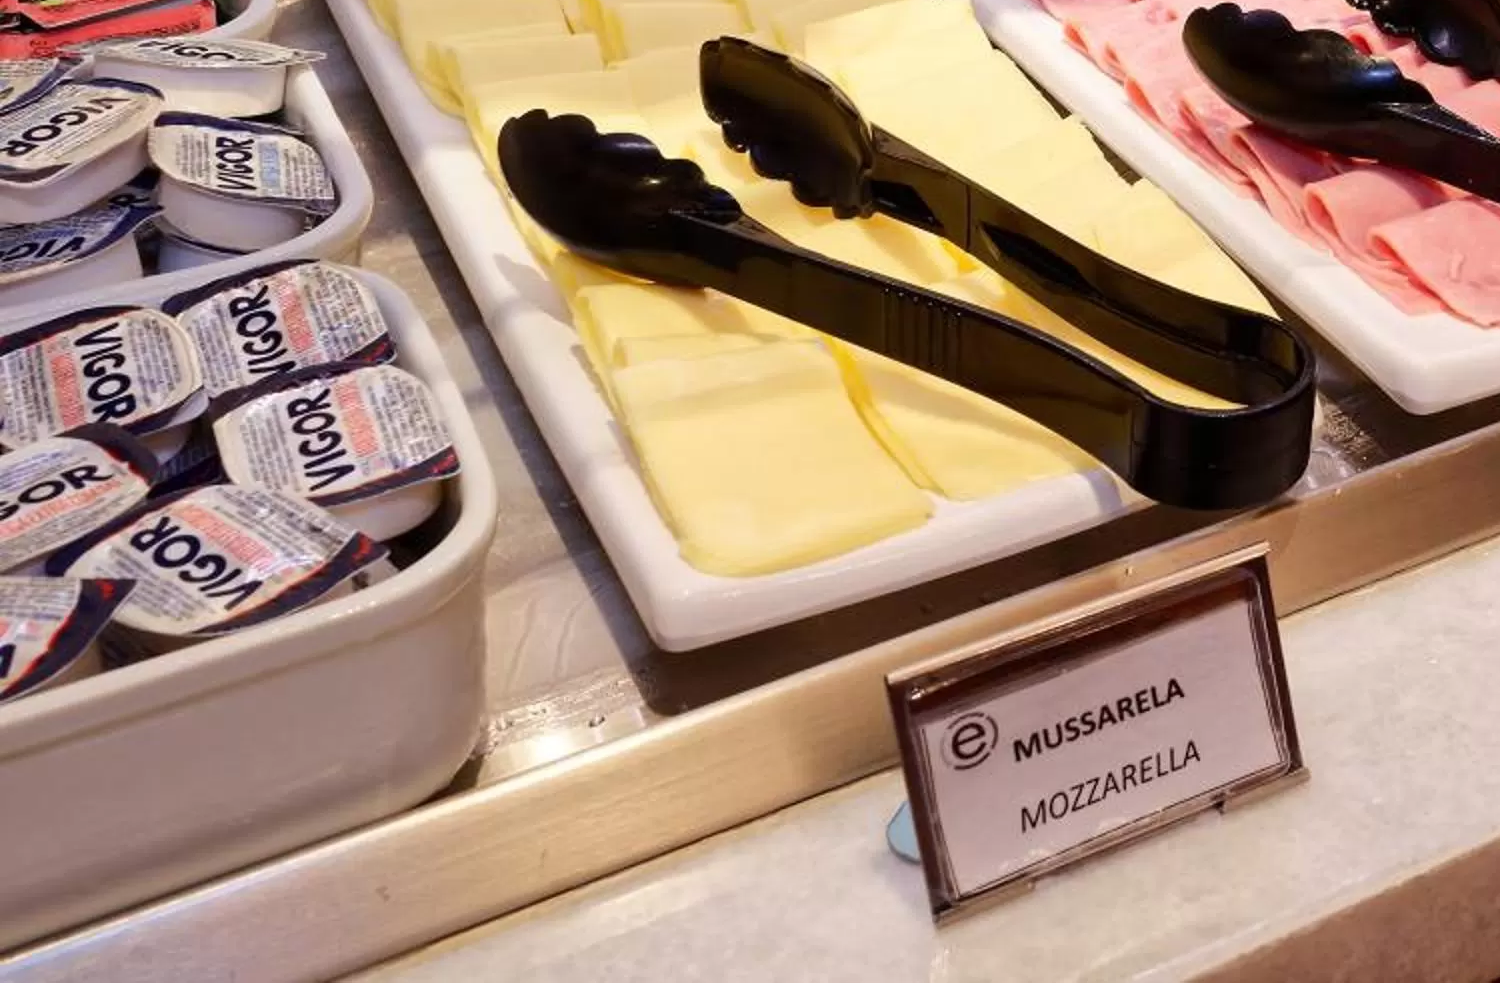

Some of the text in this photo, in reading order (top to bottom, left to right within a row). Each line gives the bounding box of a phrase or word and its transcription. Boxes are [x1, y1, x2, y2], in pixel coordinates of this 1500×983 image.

[0, 97, 132, 157] VIGOR
[216, 137, 257, 190] VIGOR
[74, 322, 137, 423] VIGOR
[287, 388, 355, 492] VIGOR
[130, 517, 263, 610] VIGOR
[1013, 678, 1185, 762] MUSSARELA
[1020, 740, 1201, 833] MOZZARELLA
